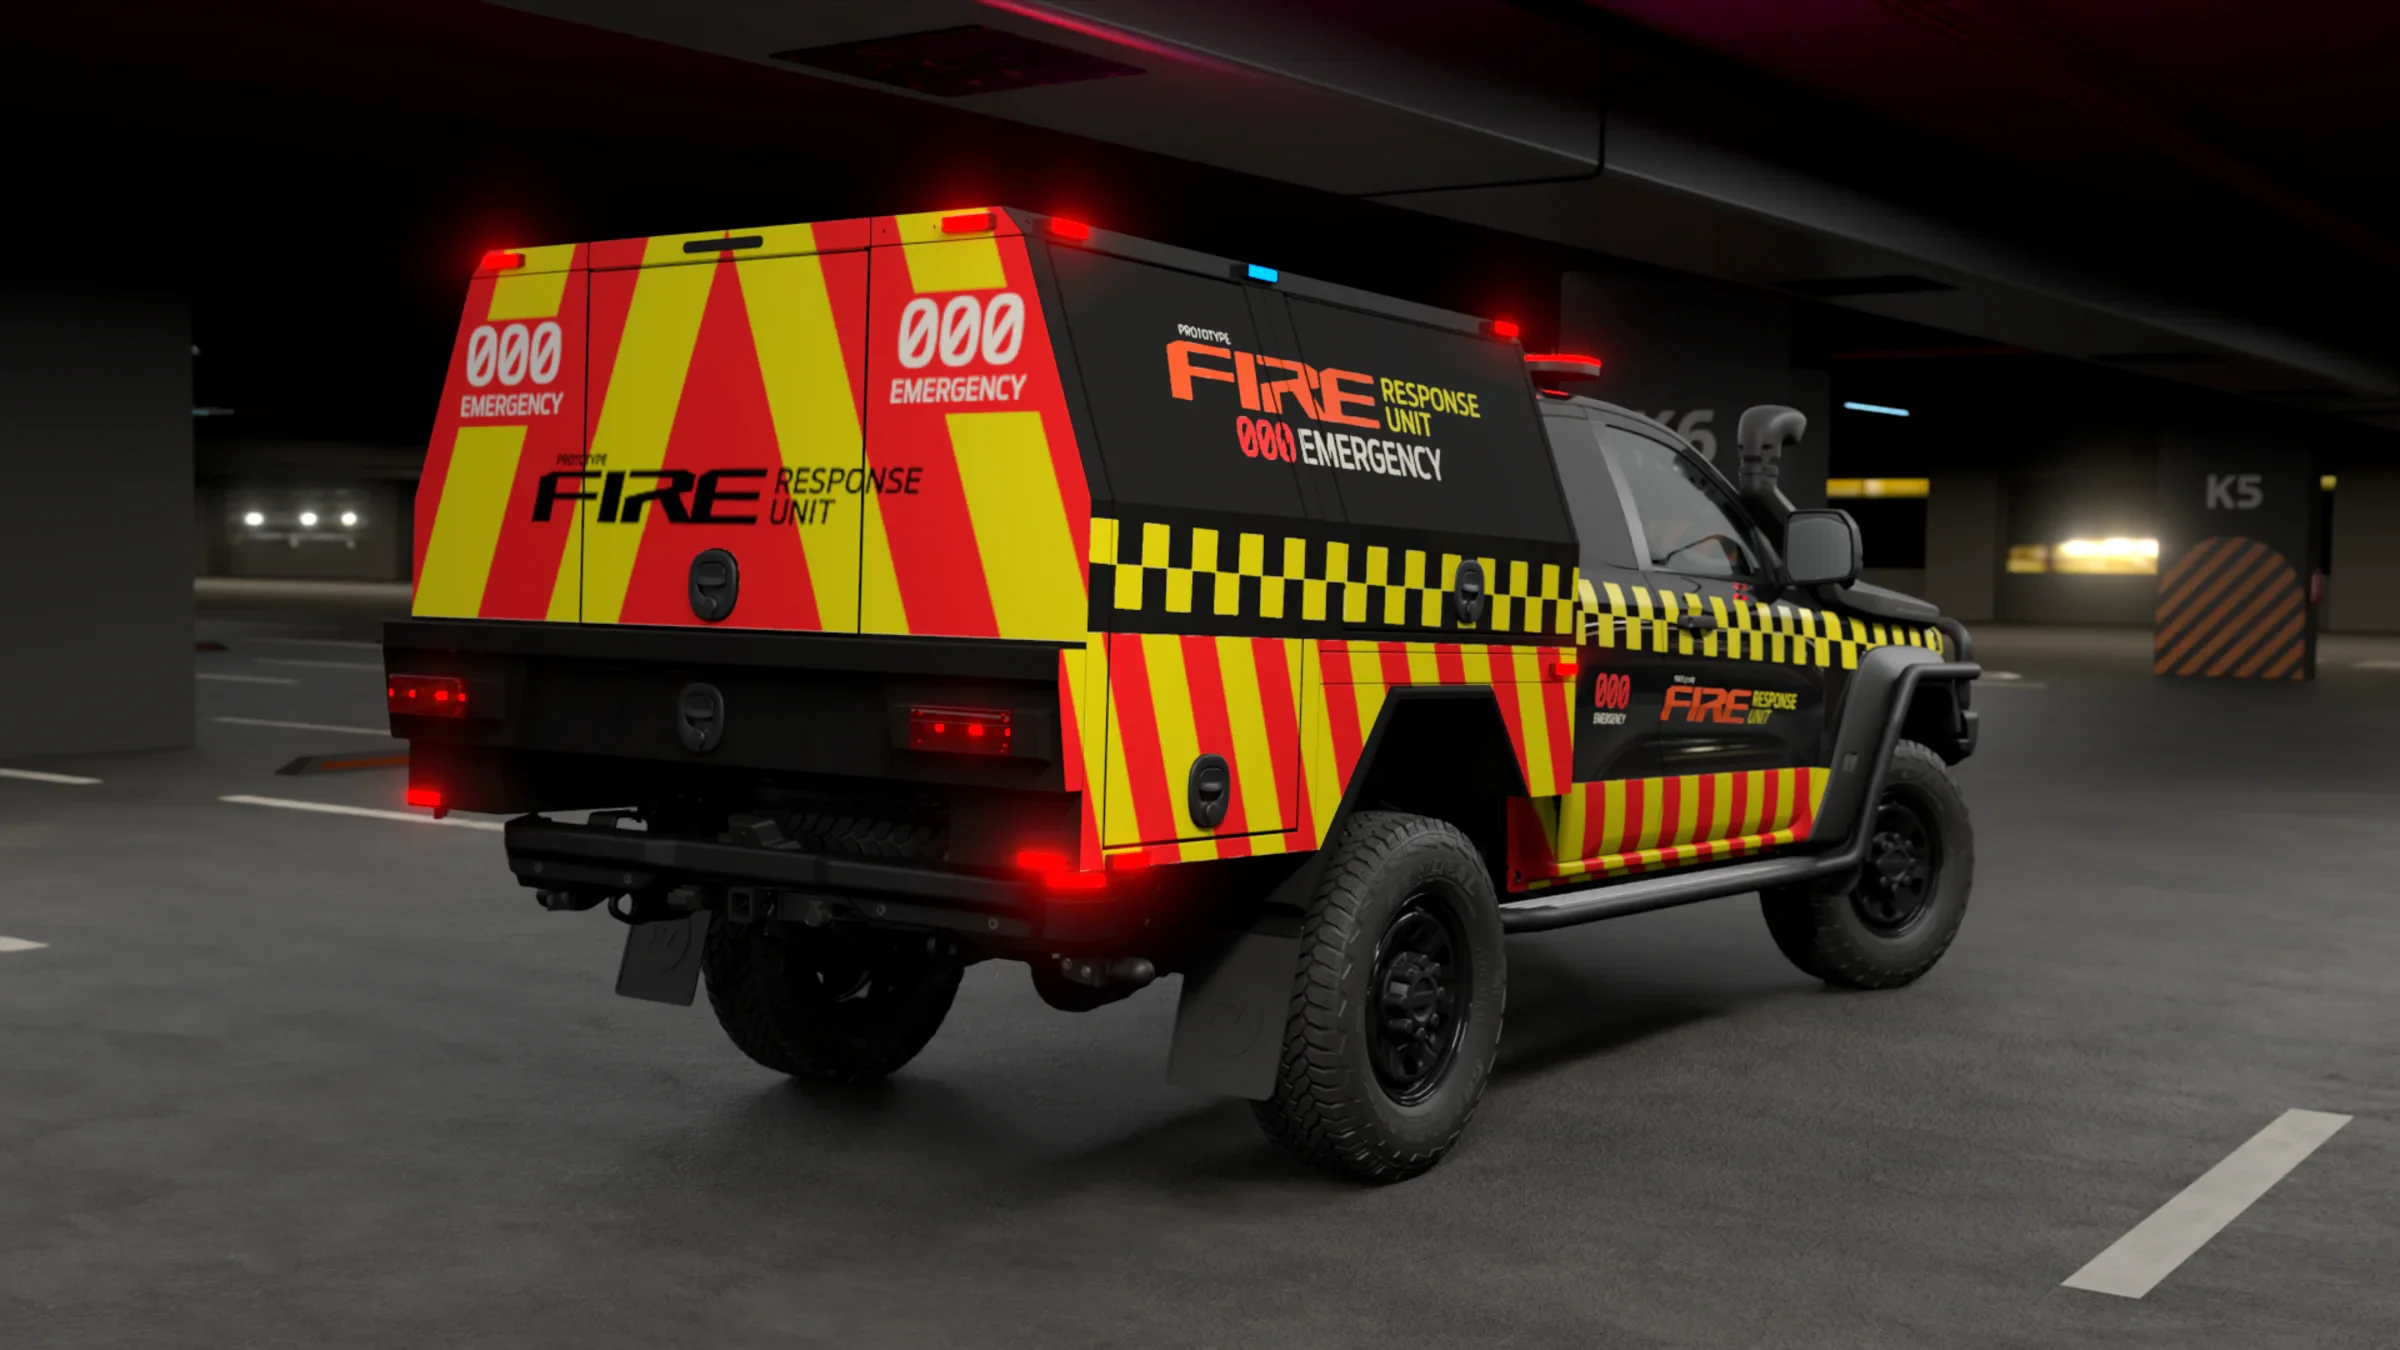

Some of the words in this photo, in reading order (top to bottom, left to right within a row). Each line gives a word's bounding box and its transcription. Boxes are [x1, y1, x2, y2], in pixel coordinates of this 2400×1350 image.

[897, 292, 1025, 369] 000
[1177, 323, 1232, 346] PROTOTYPE
[466, 321, 562, 387] 000
[889, 374, 1027, 405] EMERGENCY
[1165, 340, 1381, 430] FIRE
[1379, 377, 1482, 419] RESPONSE
[460, 392, 563, 417] EMERGENCY
[1385, 405, 1432, 437] UNIT
[556, 453, 608, 466] PROTOTYPE
[1236, 414, 1297, 464] 000
[1297, 427, 1443, 482] EMERGENCY
[531, 468, 768, 525] FIRE
[774, 467, 923, 495] RESPONSE
[2206, 474, 2263, 510] K5
[770, 499, 832, 525] UNIT
[1595, 672, 1631, 710] 000
[1659, 685, 1752, 724] FIRE
[1751, 690, 1798, 710] RESPONSE
[1747, 709, 1772, 725] UNIT
